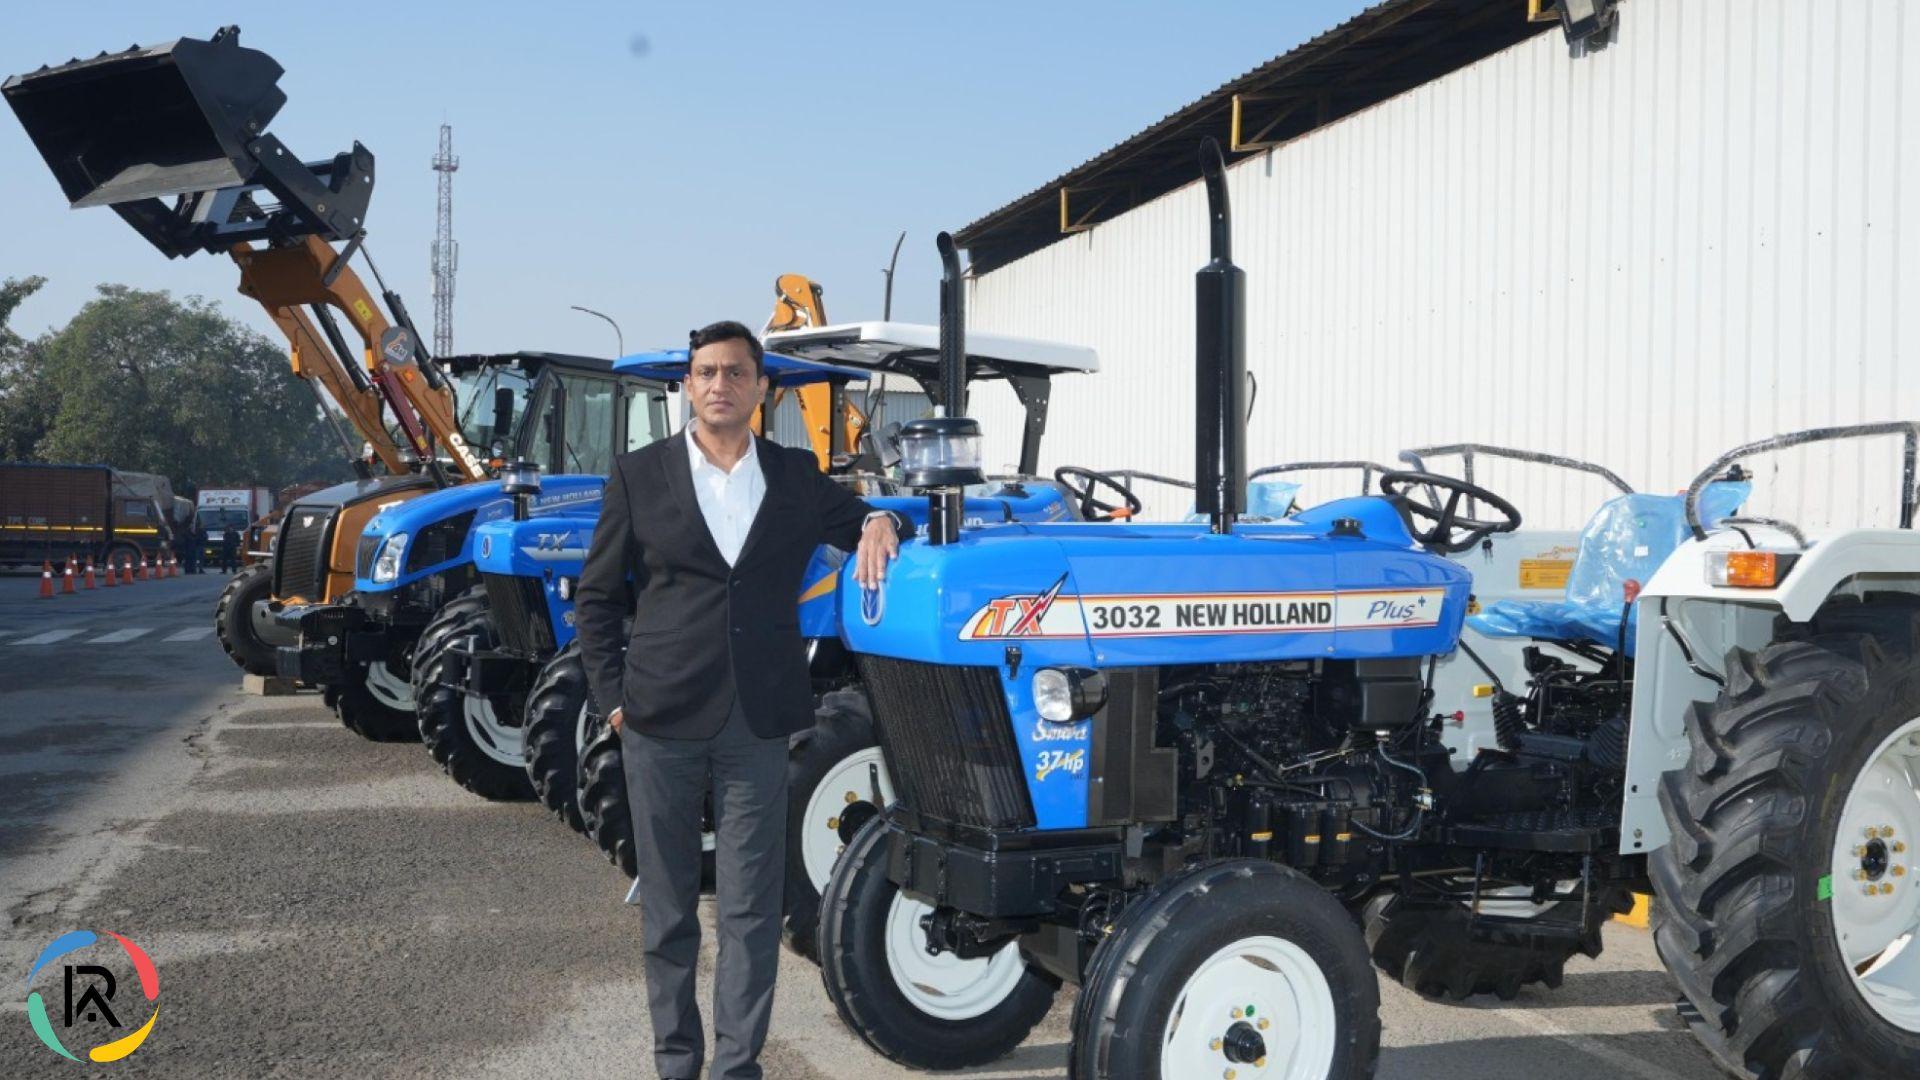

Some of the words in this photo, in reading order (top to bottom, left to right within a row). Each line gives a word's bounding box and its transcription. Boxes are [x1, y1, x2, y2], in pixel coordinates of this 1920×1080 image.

[450, 433, 484, 479] CASE
[537, 529, 571, 551] TX
[989, 580, 1062, 636] TX
[1092, 605, 1161, 629] 3032
[1176, 603, 1227, 627] NEW
[1233, 602, 1332, 625] HOLLAND
